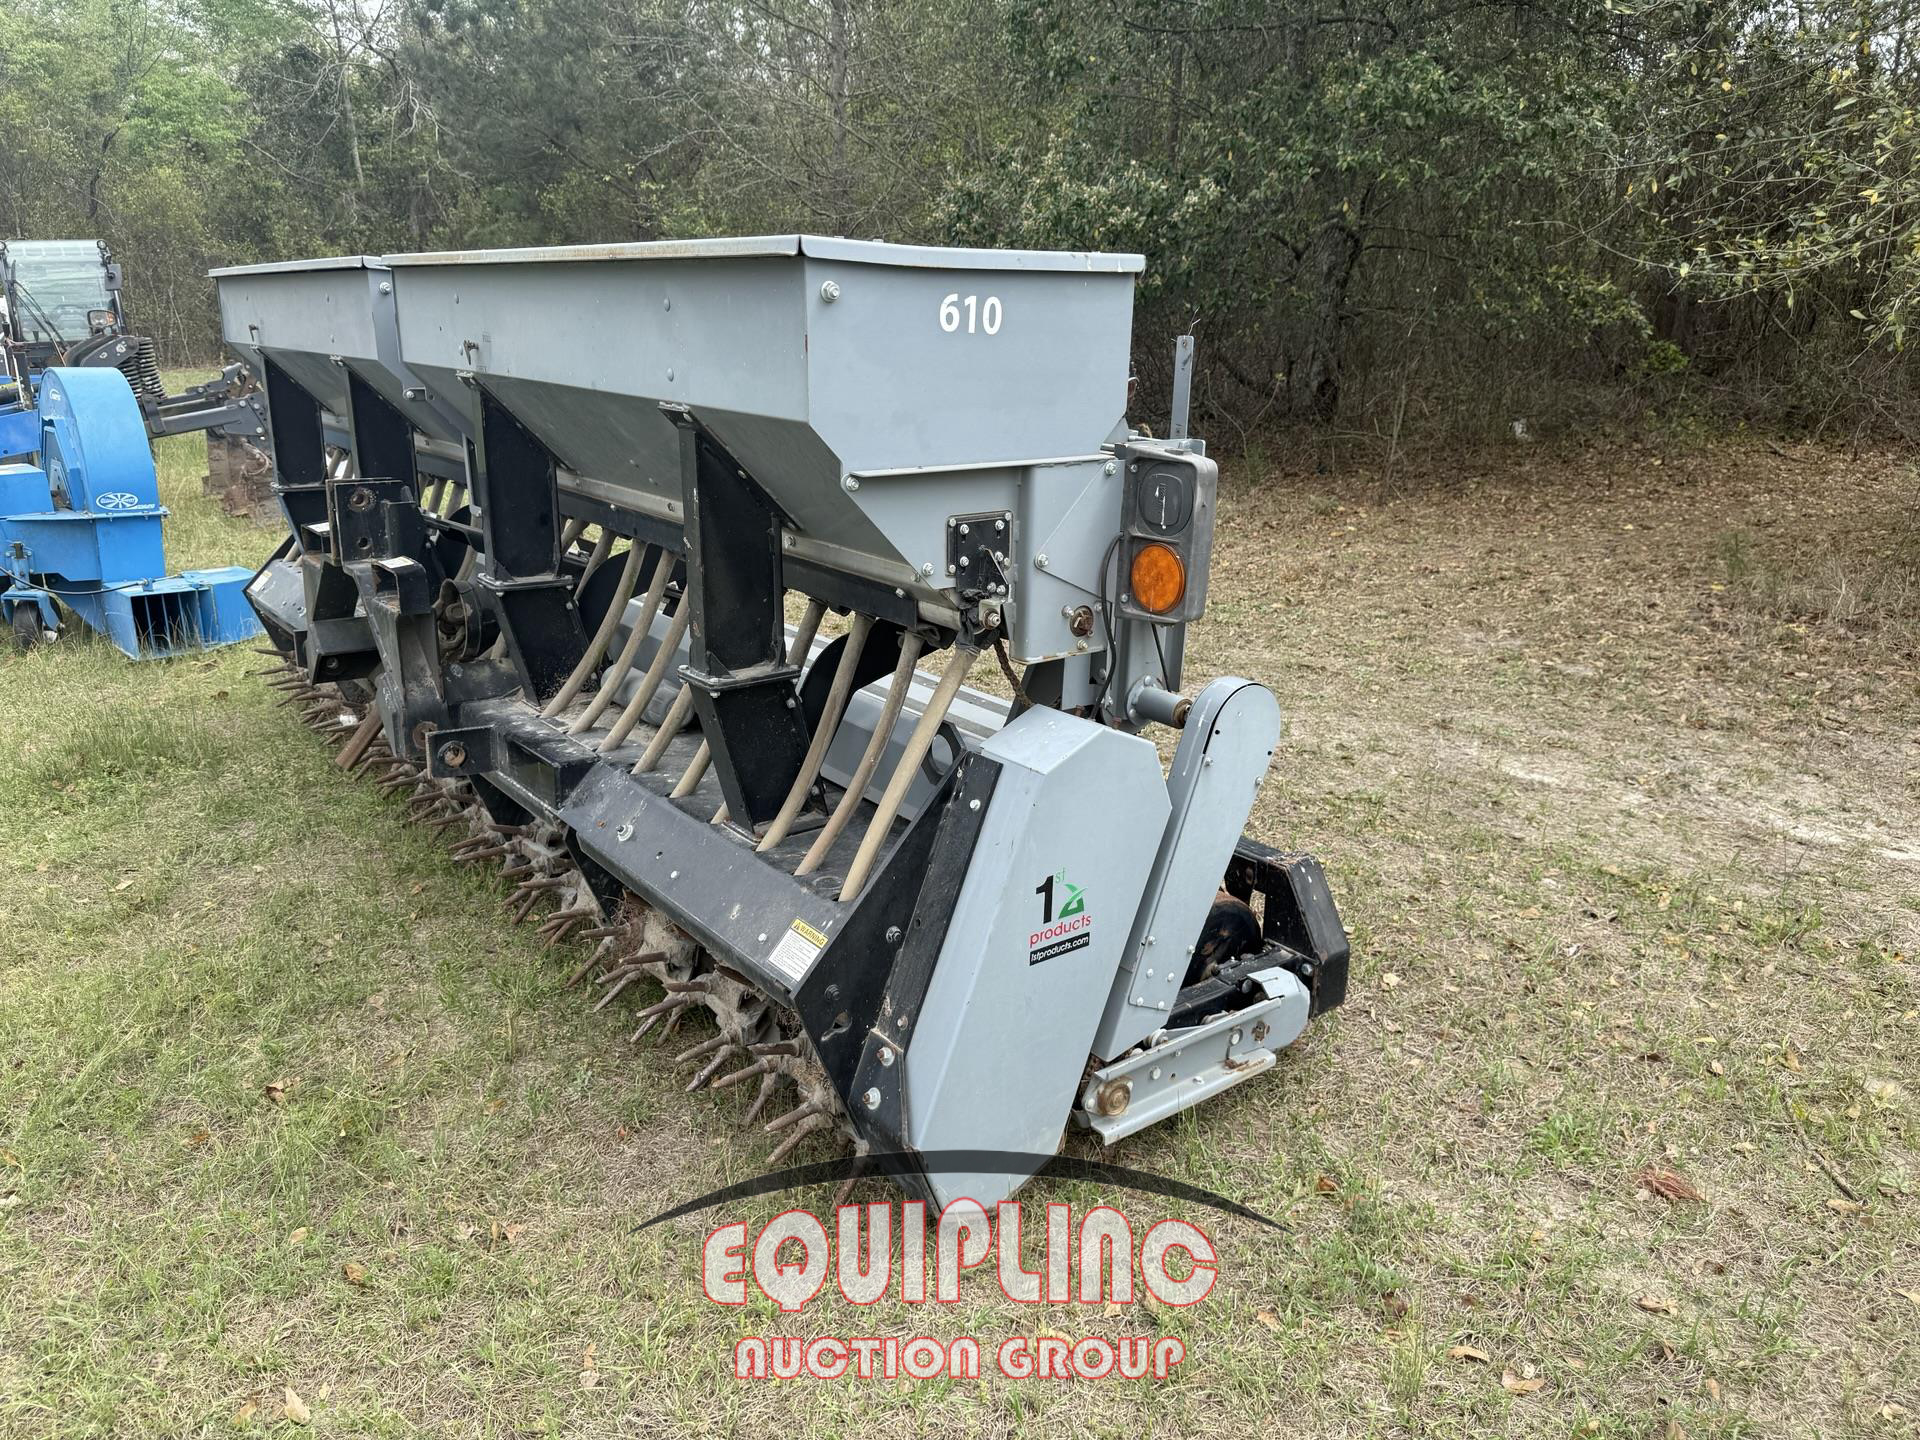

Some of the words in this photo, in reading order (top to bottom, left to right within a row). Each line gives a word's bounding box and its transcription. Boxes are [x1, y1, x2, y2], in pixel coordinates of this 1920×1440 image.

[940, 293, 1002, 335] 610
[799, 925, 825, 946] WARNING
[1029, 914, 1092, 948] products
